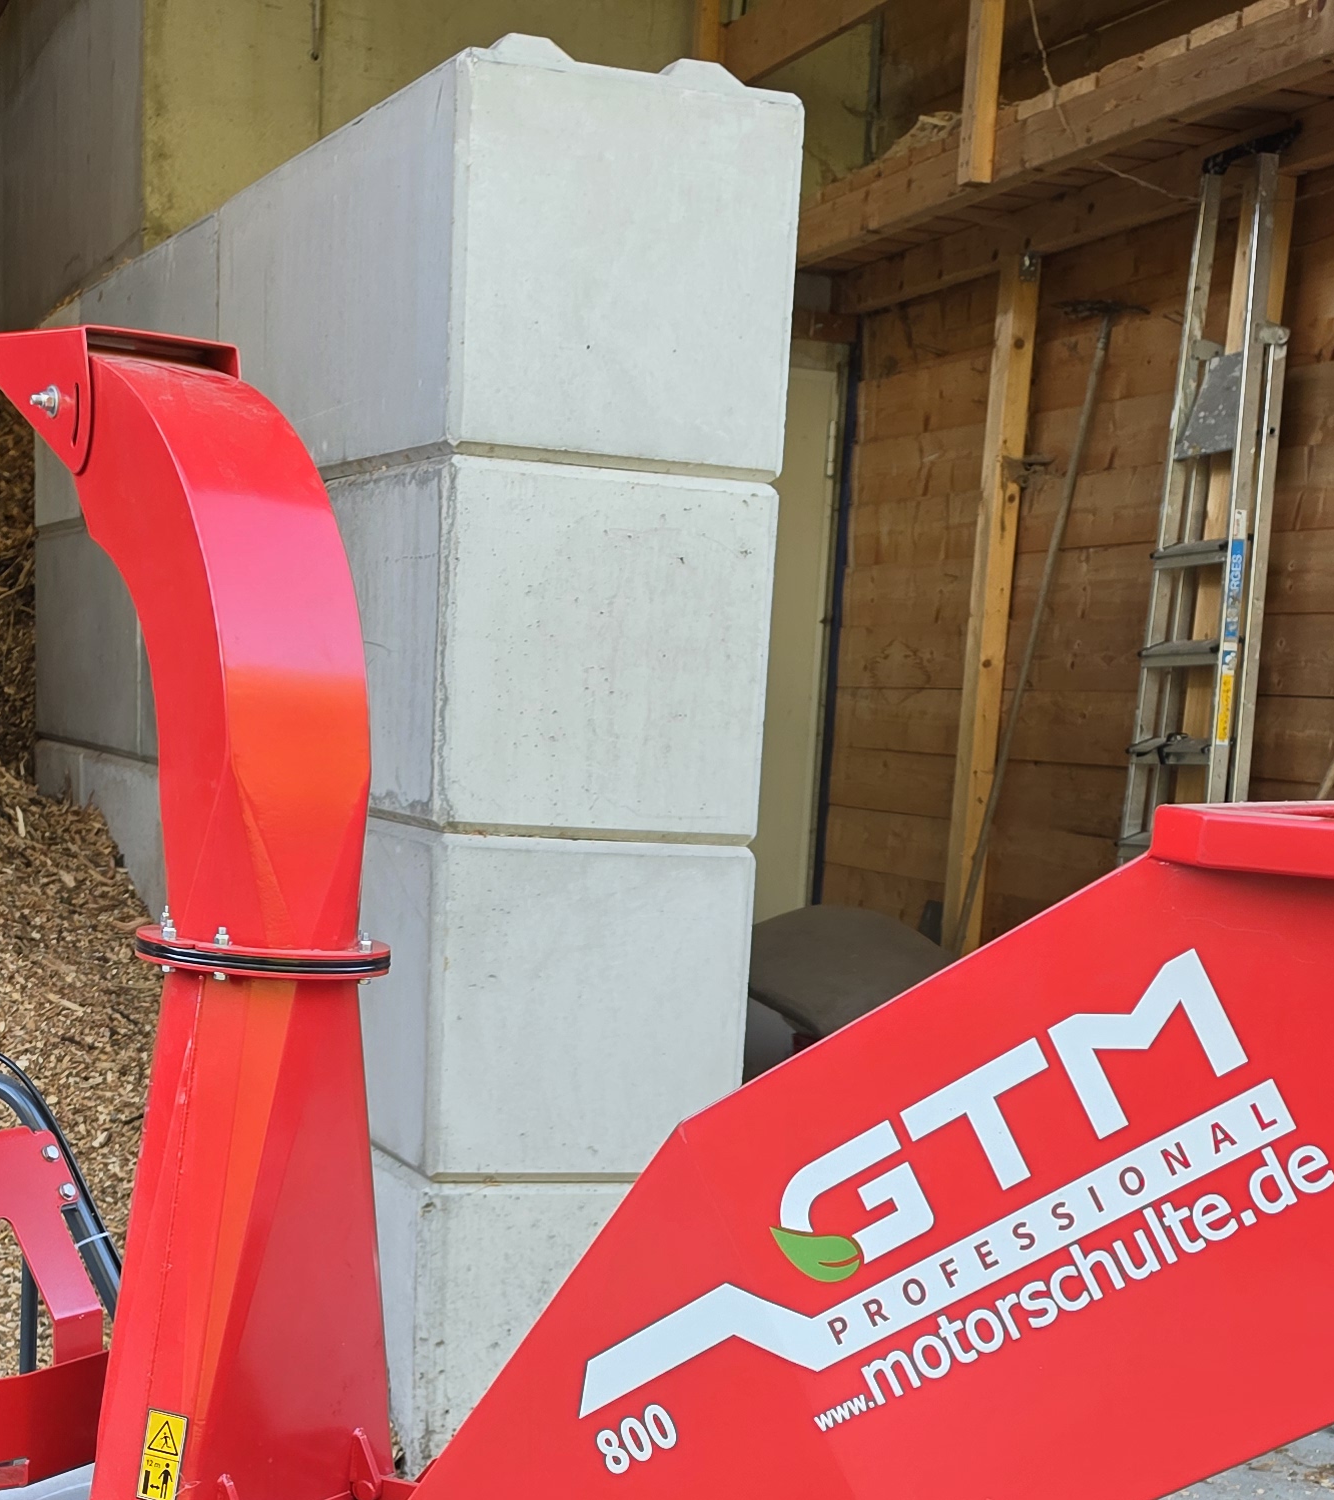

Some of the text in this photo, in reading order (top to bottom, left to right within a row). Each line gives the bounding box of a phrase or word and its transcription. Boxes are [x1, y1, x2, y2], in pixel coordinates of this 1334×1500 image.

[778, 947, 1250, 1264] GTM
[827, 1101, 1280, 1345] PROFESSIONAL
[595, 1403, 678, 1475] 800
